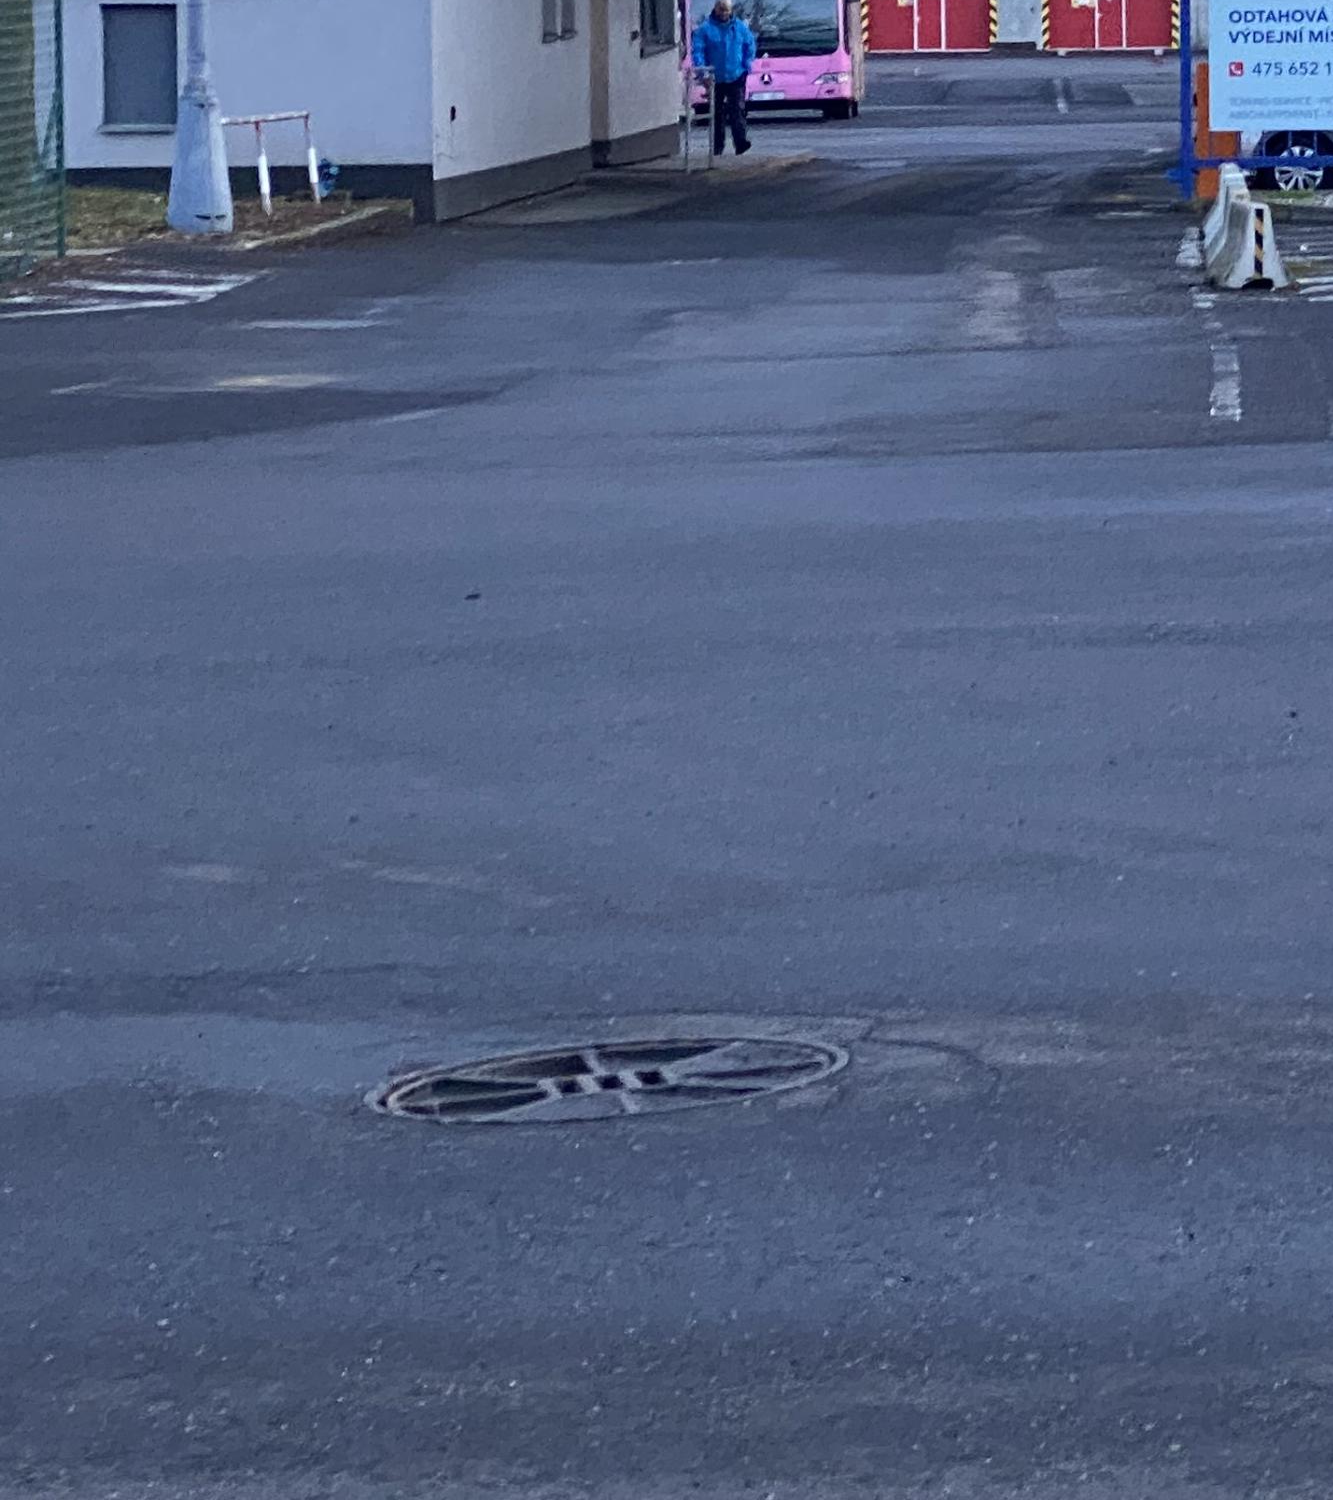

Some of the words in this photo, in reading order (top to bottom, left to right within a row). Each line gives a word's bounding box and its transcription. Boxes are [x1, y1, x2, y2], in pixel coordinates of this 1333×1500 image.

[1229, 6, 1328, 24] ODTAHOVÁ
[1229, 26, 1304, 44] VÝDEJNÍ
[1252, 62, 1283, 76] 475
[1288, 61, 1319, 76] 652
